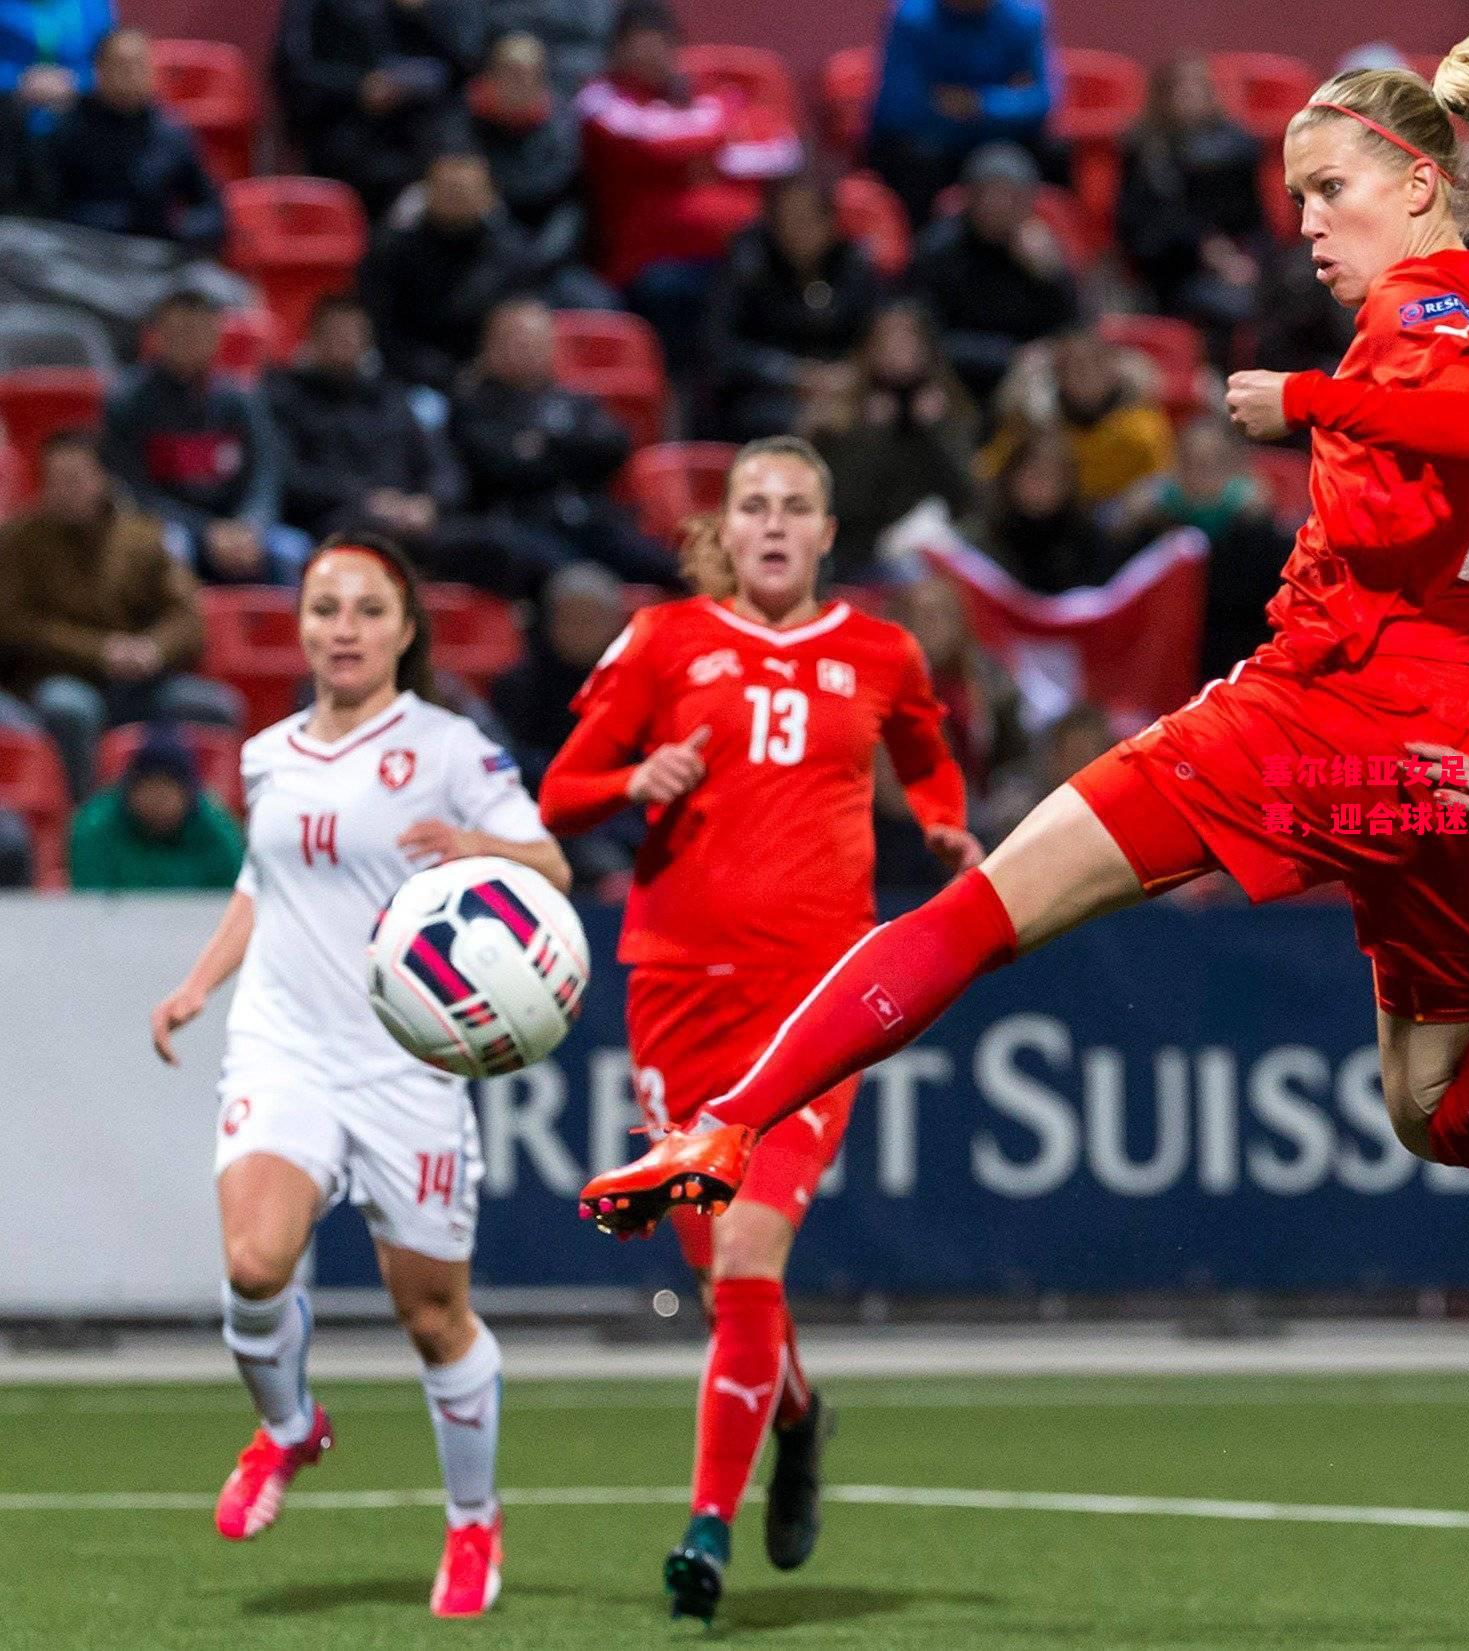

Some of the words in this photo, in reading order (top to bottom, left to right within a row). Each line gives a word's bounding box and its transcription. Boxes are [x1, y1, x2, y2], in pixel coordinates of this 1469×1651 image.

[743, 684, 810, 766] 13
[299, 813, 340, 867] 14
[414, 1151, 458, 1206] 14
